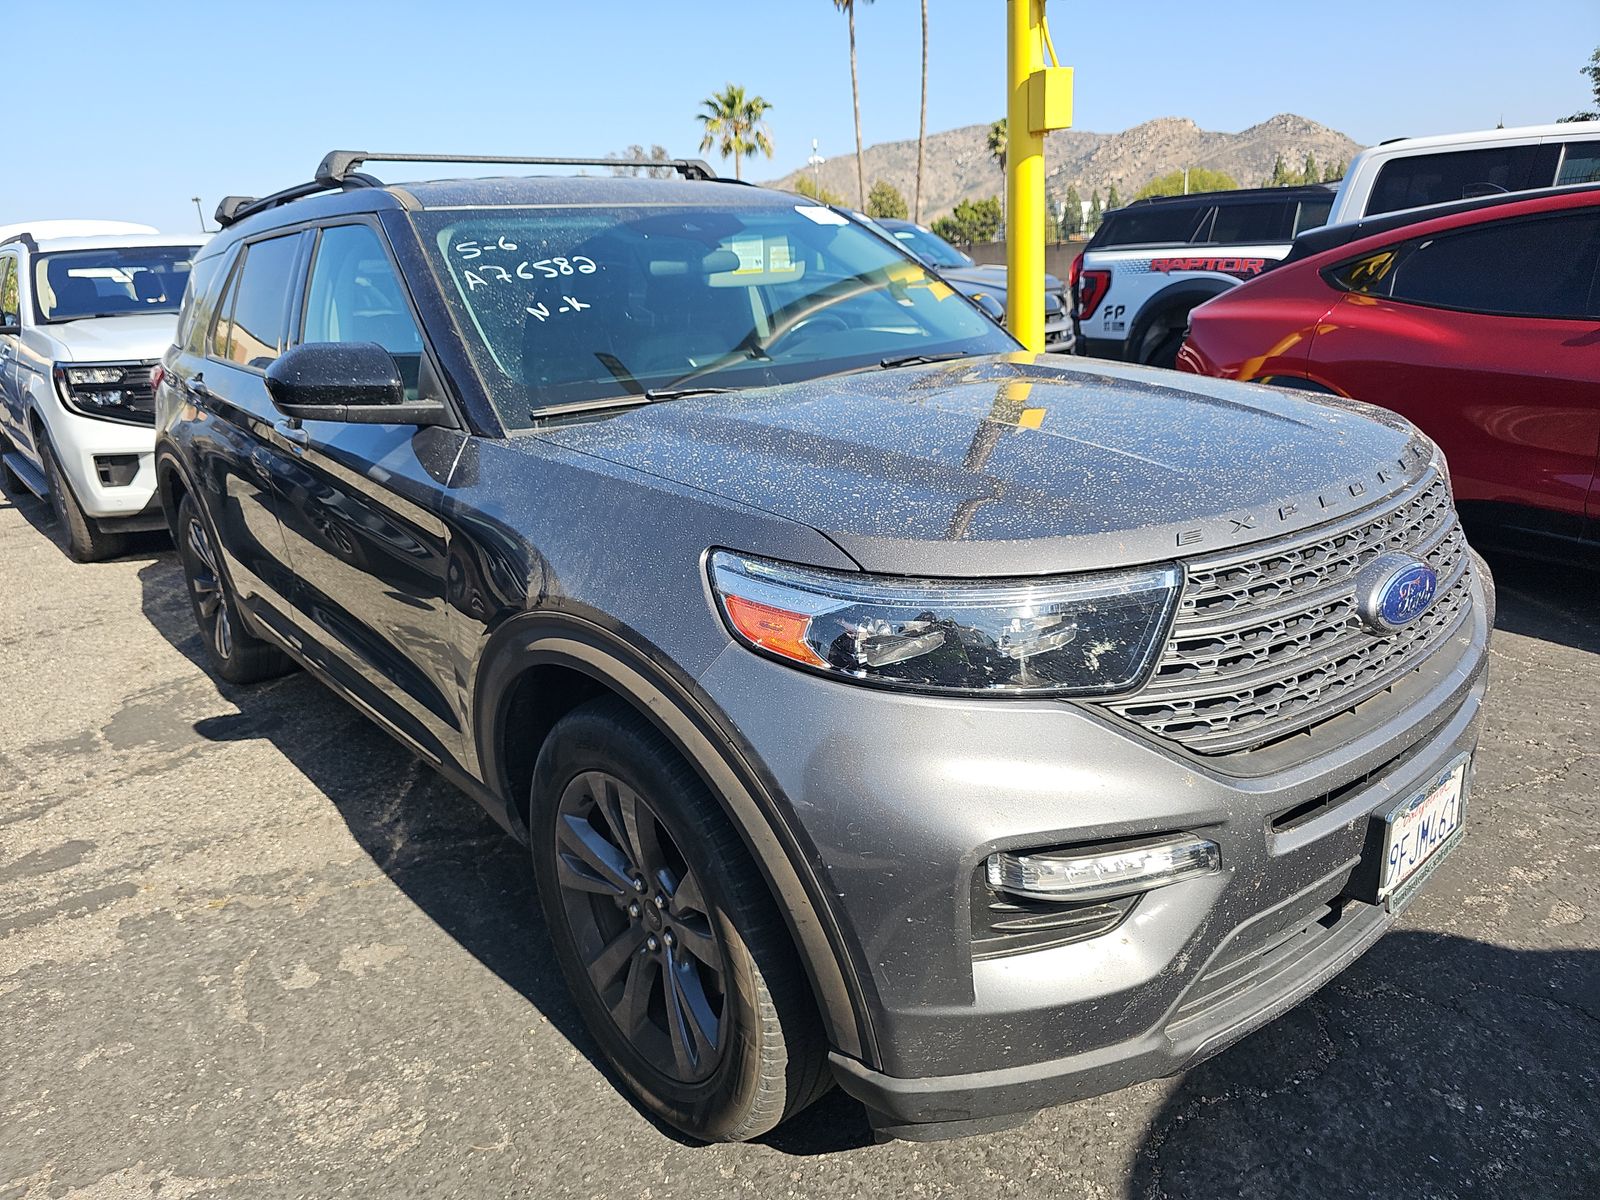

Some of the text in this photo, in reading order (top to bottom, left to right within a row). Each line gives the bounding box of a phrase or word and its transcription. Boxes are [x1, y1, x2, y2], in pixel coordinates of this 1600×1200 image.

[464, 256, 597, 291] A76582
[1151, 258, 1265, 275] RAPTOR
[1176, 444, 1431, 547] EXPLORER
[1386, 793, 1457, 887] 9FJM461
